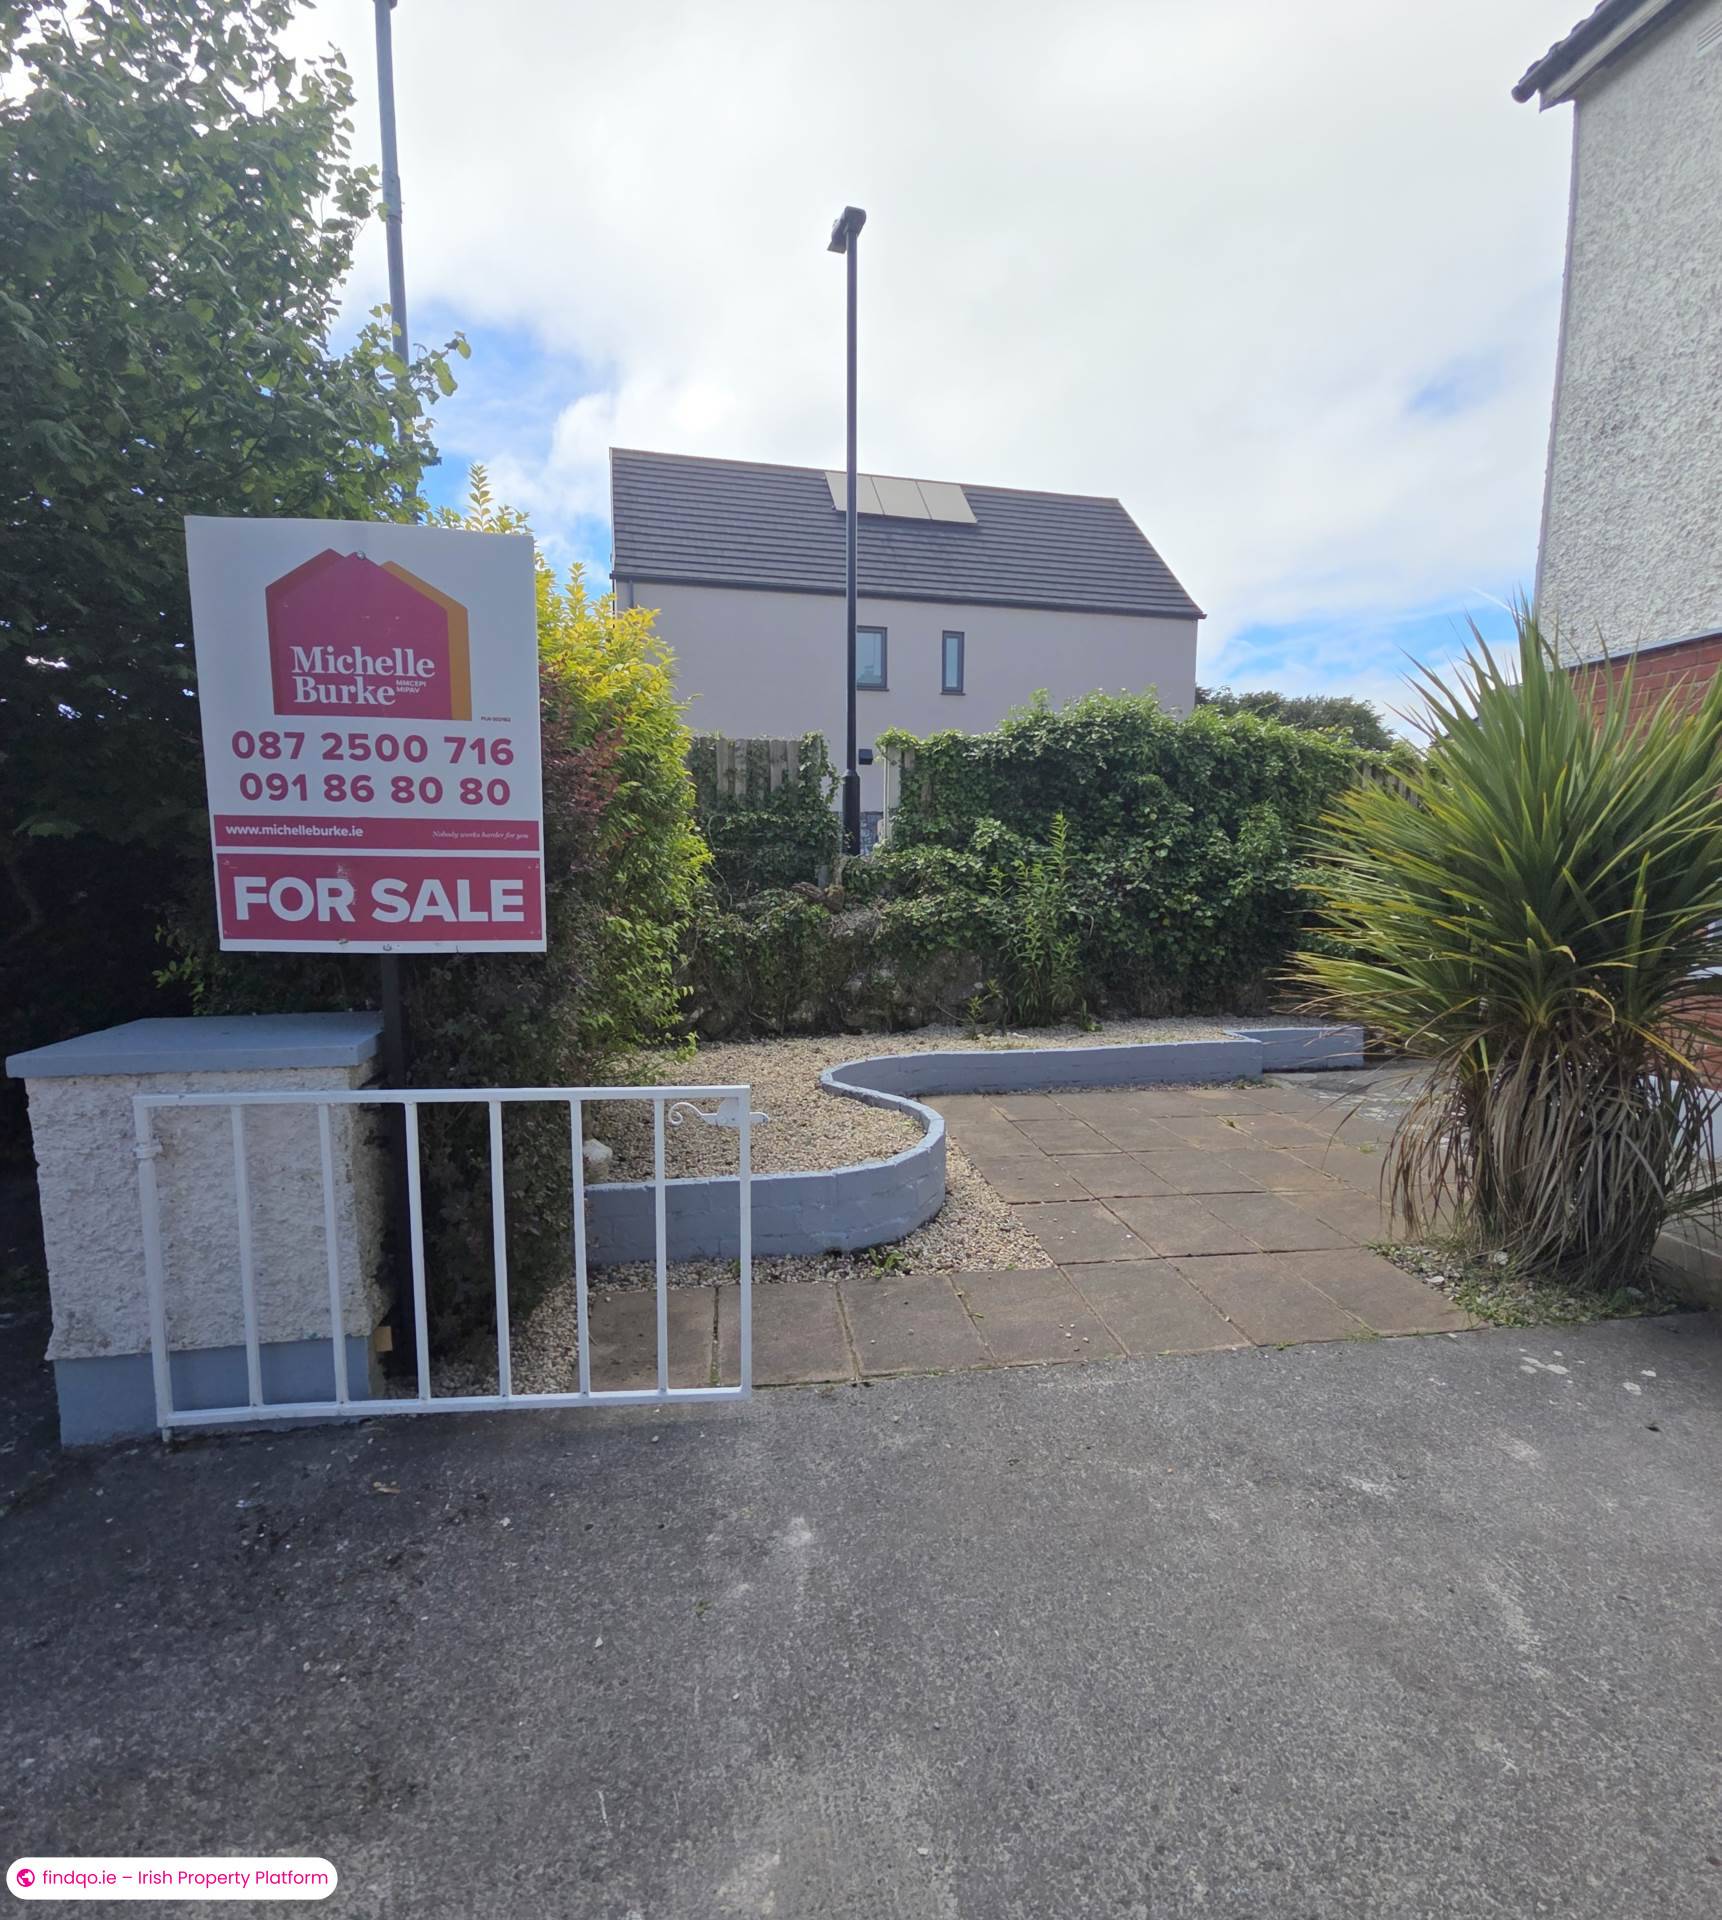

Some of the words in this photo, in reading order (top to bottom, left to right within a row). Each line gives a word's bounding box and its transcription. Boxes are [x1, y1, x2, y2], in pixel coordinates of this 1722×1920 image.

[289, 645, 436, 678] Michelle
[291, 675, 396, 706] Burke
[396, 686, 420, 694] MIPAV
[231, 730, 305, 760] 087
[320, 732, 429, 763] 2500
[443, 735, 515, 766] 716
[239, 772, 308, 802] 091
[323, 774, 375, 803] 86
[390, 775, 443, 805] 80
[459, 777, 511, 806] 80
[225, 823, 364, 838] www.michelleburke.ie
[233, 876, 356, 922] FOR
[371, 877, 525, 923] SALE
